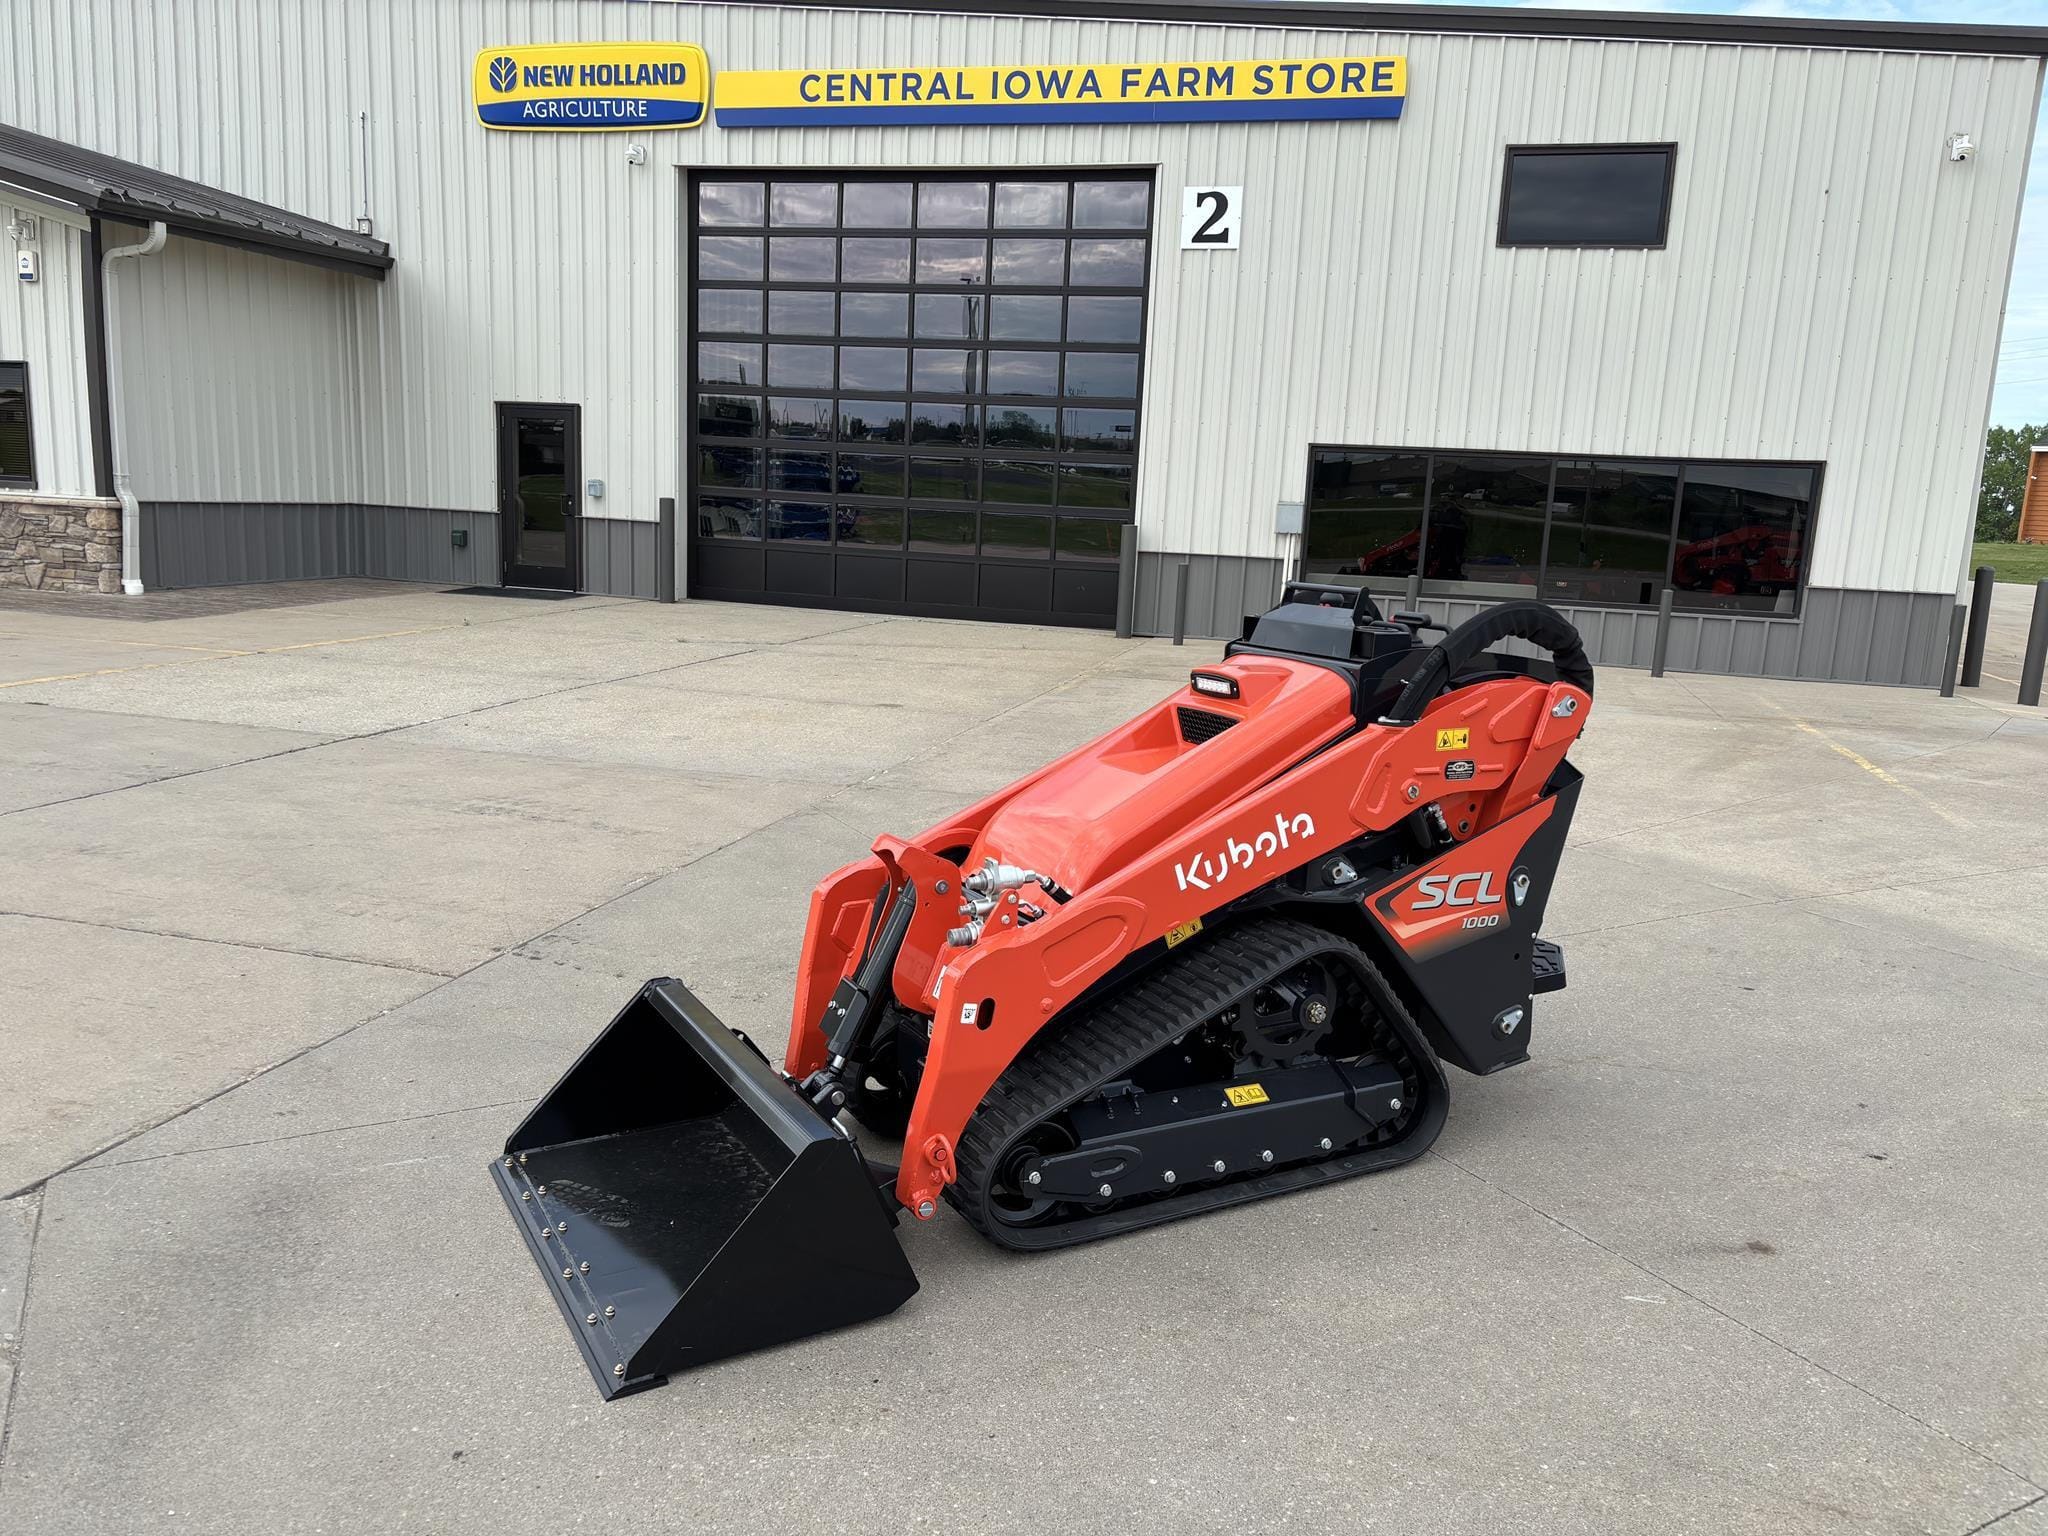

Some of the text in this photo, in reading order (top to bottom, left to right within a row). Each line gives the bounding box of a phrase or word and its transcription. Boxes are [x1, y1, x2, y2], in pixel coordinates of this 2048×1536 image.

[523, 62, 687, 88] NEW HOLLAND
[799, 61, 1396, 103] CENTRAL IOWA FARM STORE
[522, 100, 648, 118] AGRICULTURE
[1191, 190, 1230, 244] 2
[1174, 813, 1315, 891] Kubota
[1410, 871, 1503, 911] SCL
[1461, 914, 1500, 929] 1000
